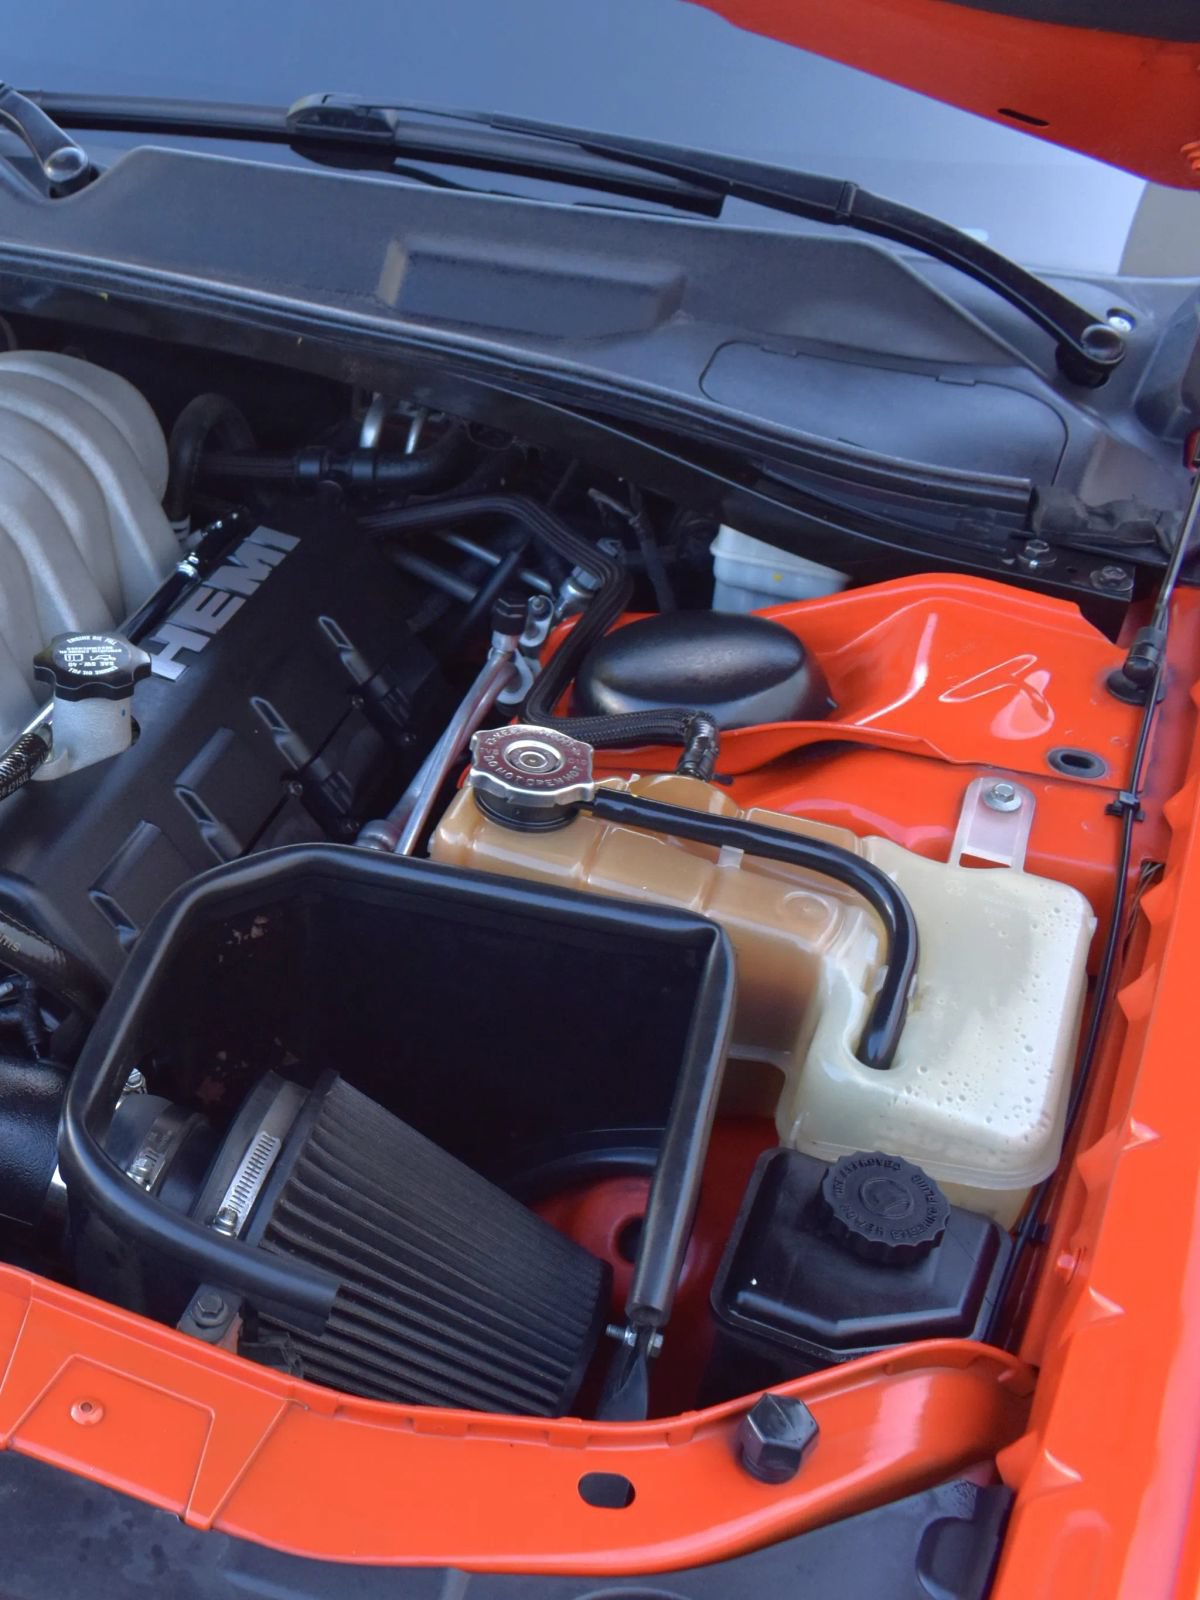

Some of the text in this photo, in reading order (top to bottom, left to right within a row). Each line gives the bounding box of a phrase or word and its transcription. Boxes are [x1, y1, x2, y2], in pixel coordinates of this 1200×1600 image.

[150, 524, 302, 683] HEMI
[483, 754, 498, 767] DO
[495, 766, 525, 782] NOT
[526, 776, 564, 787] OPEN
